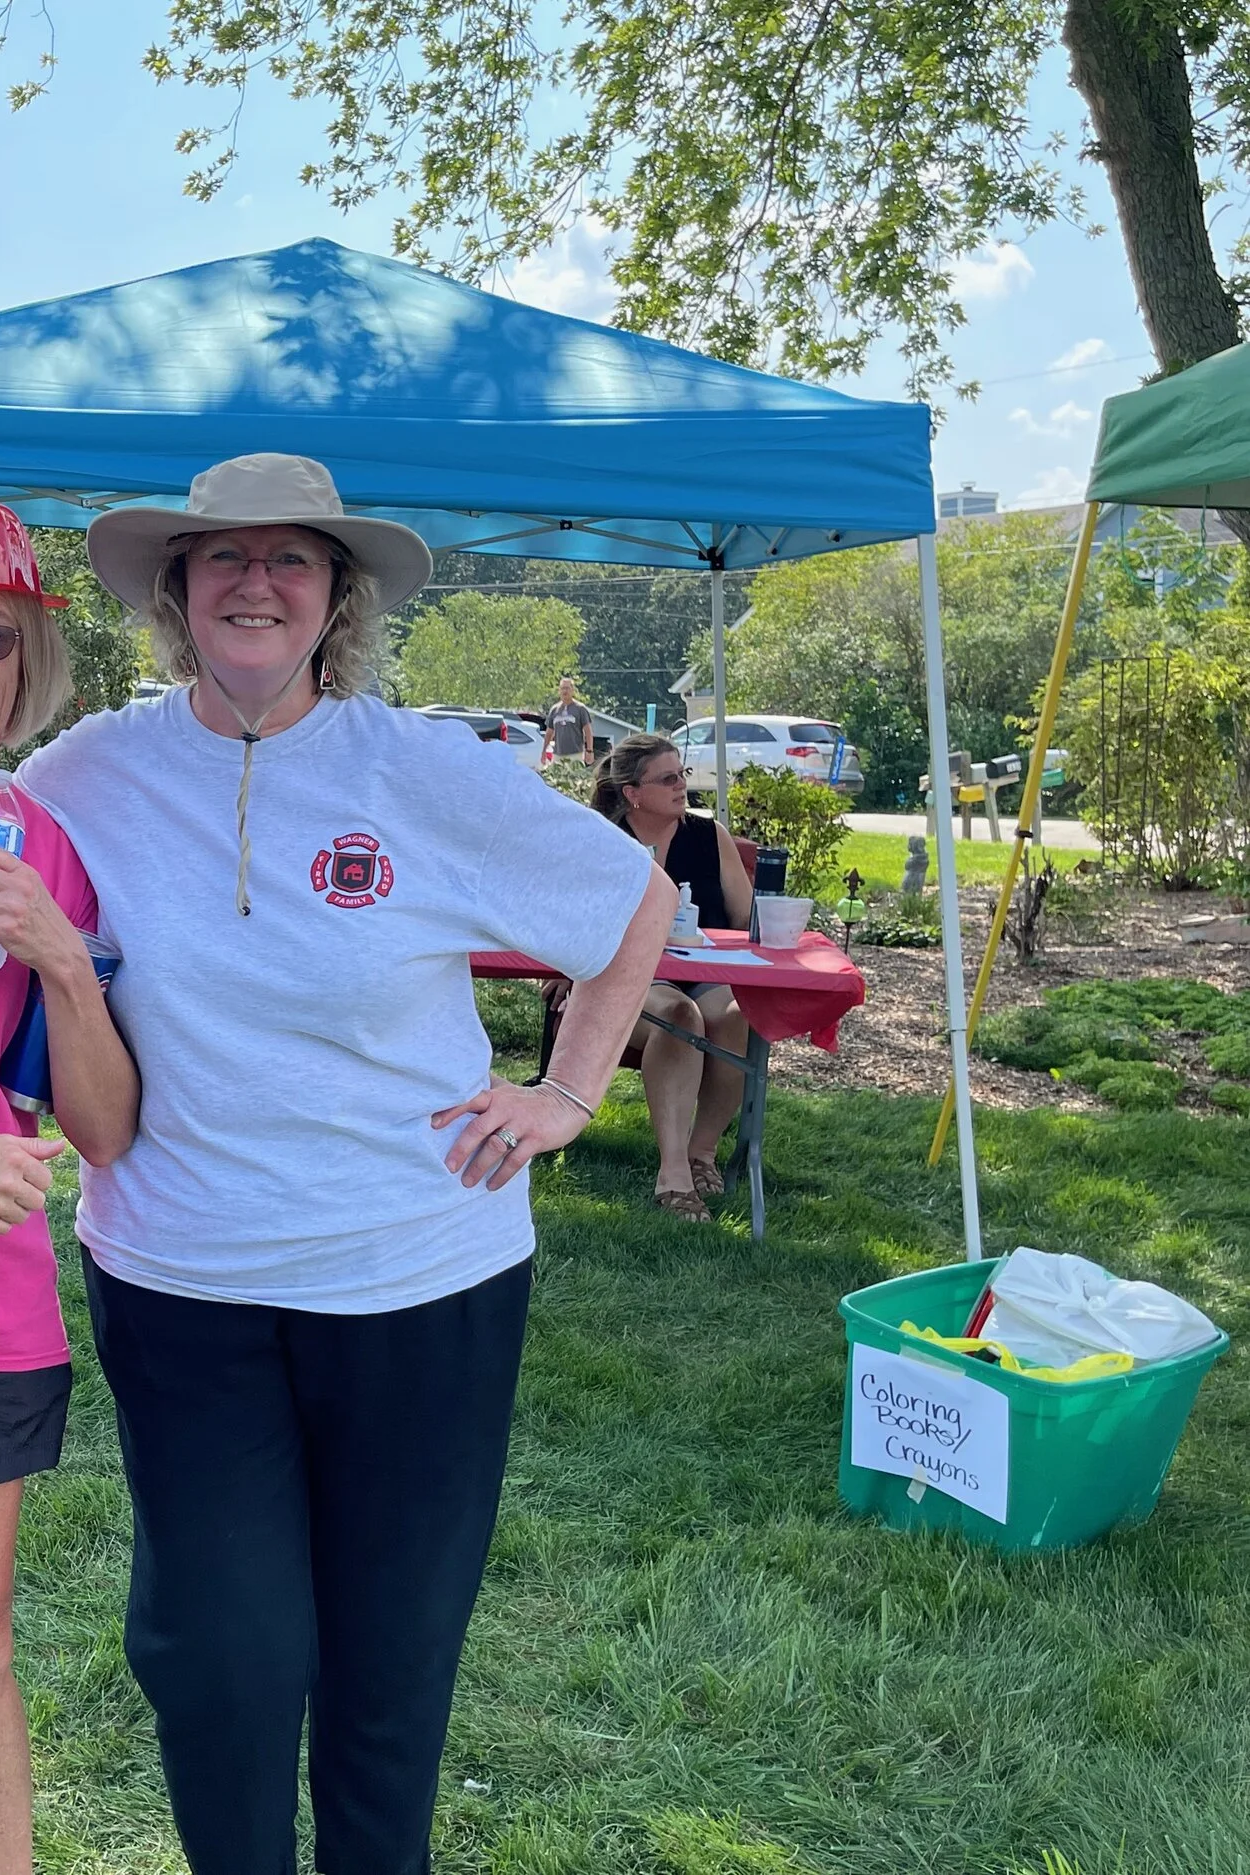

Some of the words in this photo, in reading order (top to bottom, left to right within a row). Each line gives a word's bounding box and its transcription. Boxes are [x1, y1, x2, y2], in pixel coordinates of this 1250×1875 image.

[338, 836, 375, 847] WAGNER
[315, 856, 325, 885] FIRE
[381, 861, 390, 890] FUND
[334, 896, 366, 905] FAMILY
[860, 1373, 962, 1439] Coloring
[885, 1435, 979, 1491] Crayons
